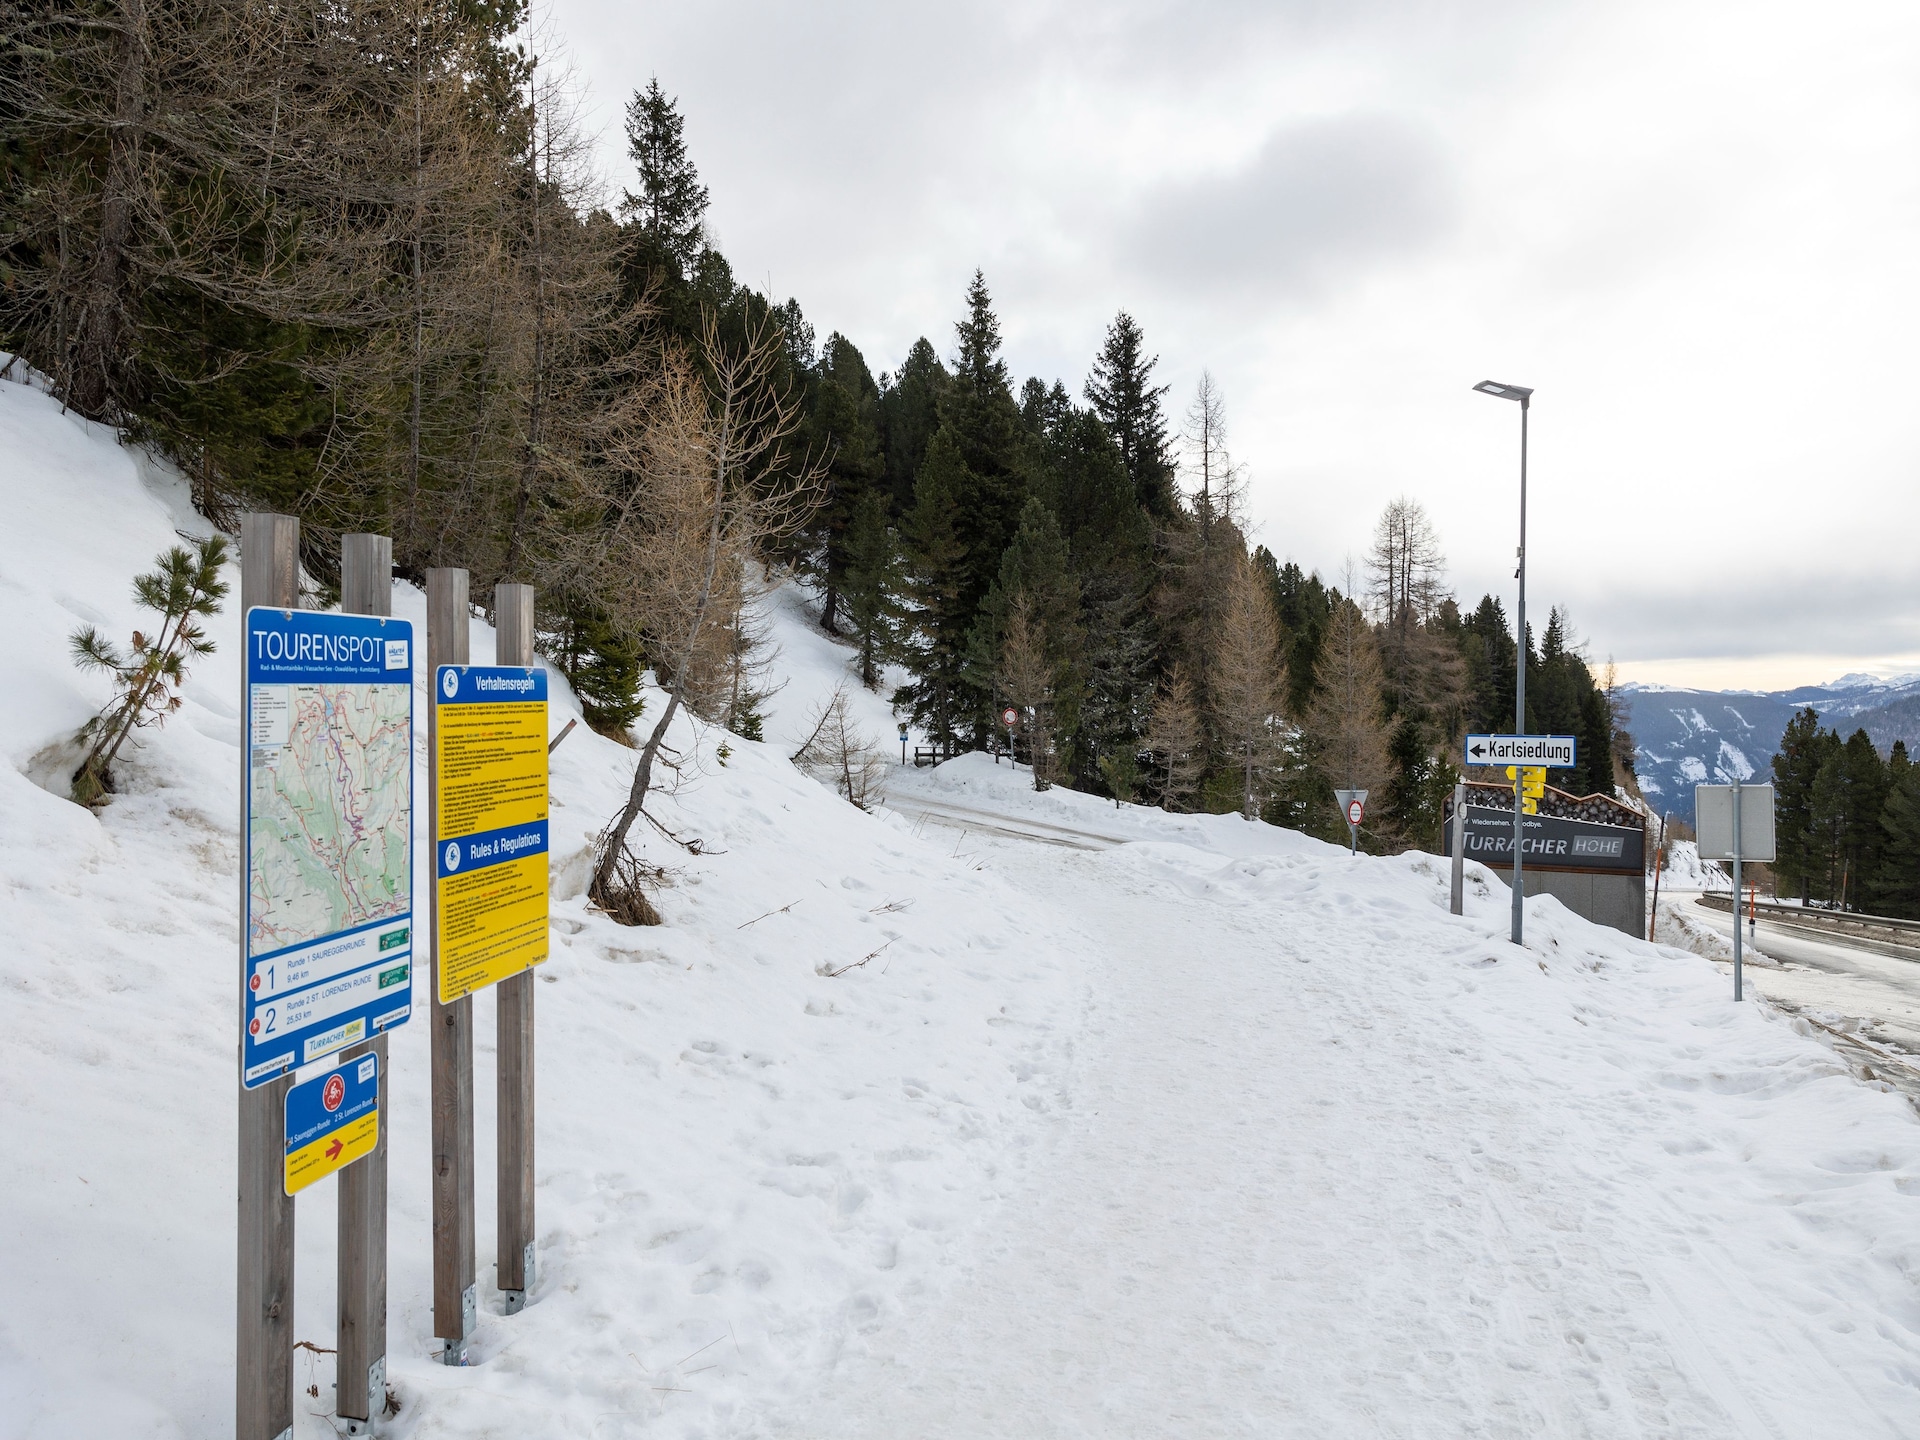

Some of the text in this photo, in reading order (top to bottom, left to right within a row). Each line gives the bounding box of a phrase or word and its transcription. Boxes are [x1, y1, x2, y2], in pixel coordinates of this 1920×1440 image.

[253, 630, 383, 663] TOURENSPOT
[275, 664, 303, 672] Mountainbike
[475, 675, 535, 694] Verhaltensregeln
[1489, 741, 1571, 763] Karlsiedlung
[1471, 818, 1511, 827] Wiedersehen.
[470, 832, 541, 860] Rules & Regulations
[1463, 831, 1620, 855] TURRACHER HÖHE
[287, 958, 305, 969] Runde
[311, 938, 366, 962] SAUREGGENRUNDE
[389, 940, 400, 948] OPEN
[267, 964, 274, 990] 1
[287, 970, 309, 983] 9,46 km
[388, 977, 399, 985] OPEN
[286, 999, 305, 1011] Runde
[311, 992, 320, 1003] ST.
[321, 982, 352, 999] LORENZEN
[353, 974, 372, 988] RUNDE
[265, 1007, 276, 1034] 2
[303, 1010, 312, 1018] km
[309, 1030, 345, 1051] TURRACHER
[317, 1119, 331, 1131] Runde
